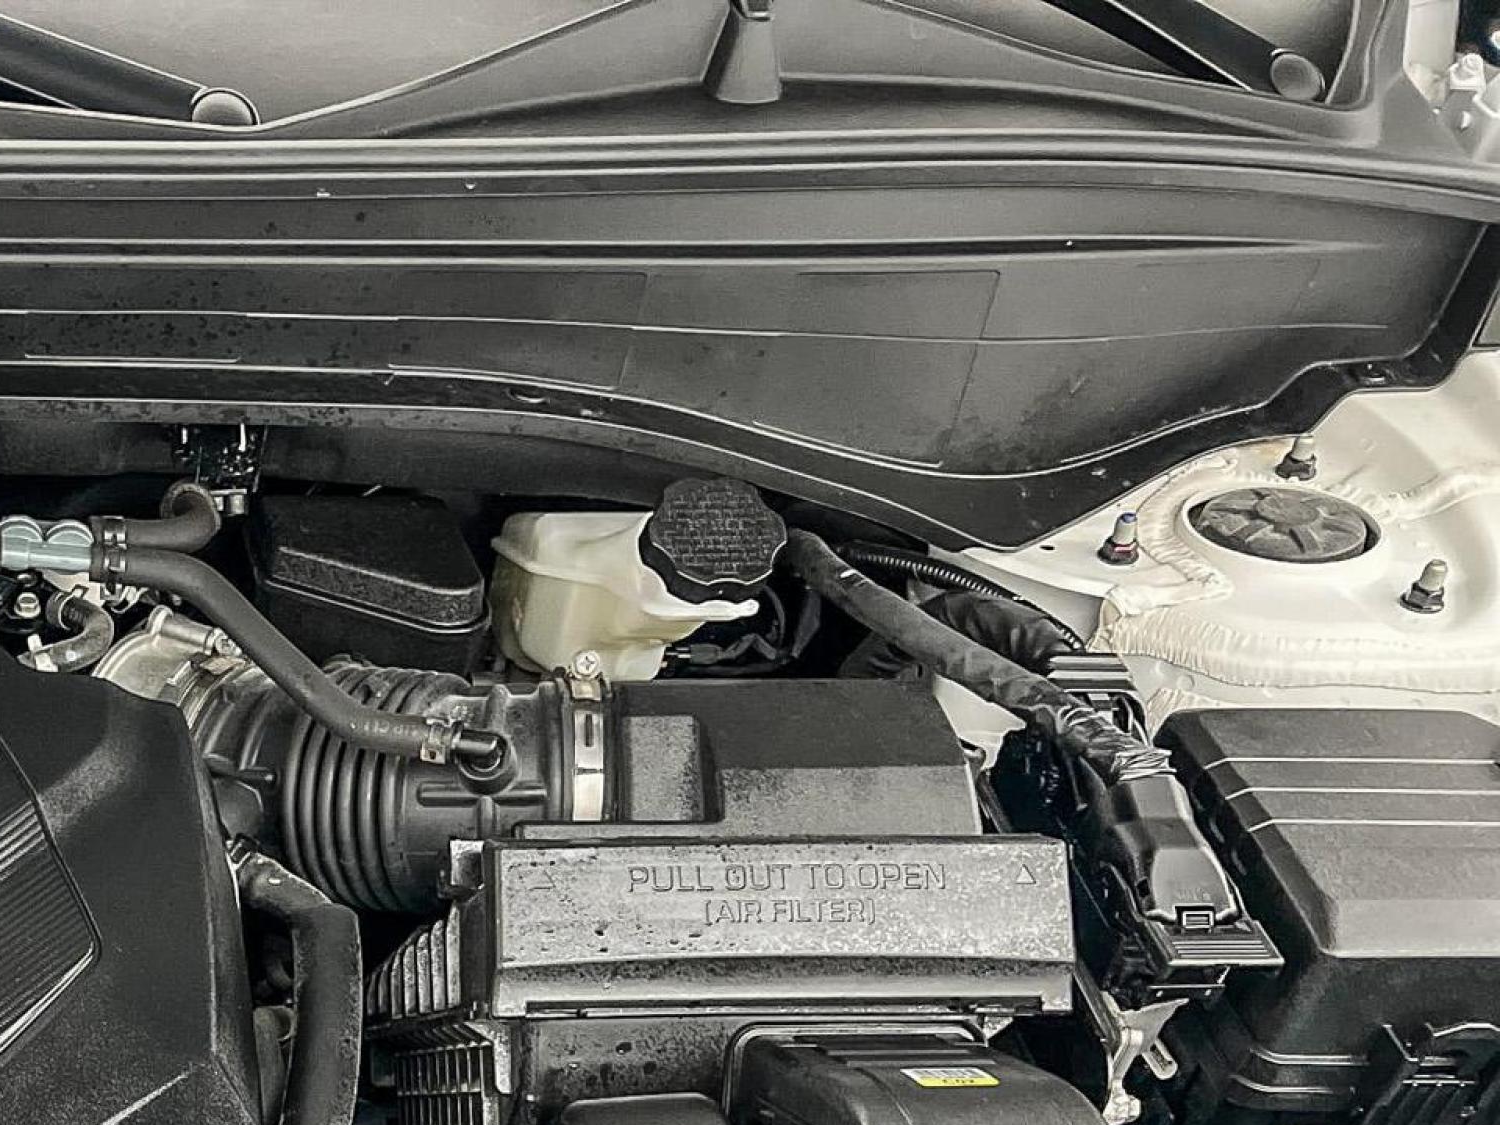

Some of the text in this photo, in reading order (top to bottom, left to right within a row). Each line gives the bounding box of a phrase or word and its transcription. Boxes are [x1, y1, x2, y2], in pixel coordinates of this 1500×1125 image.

[627, 863, 946, 893] PULL OUT TO OPEN
